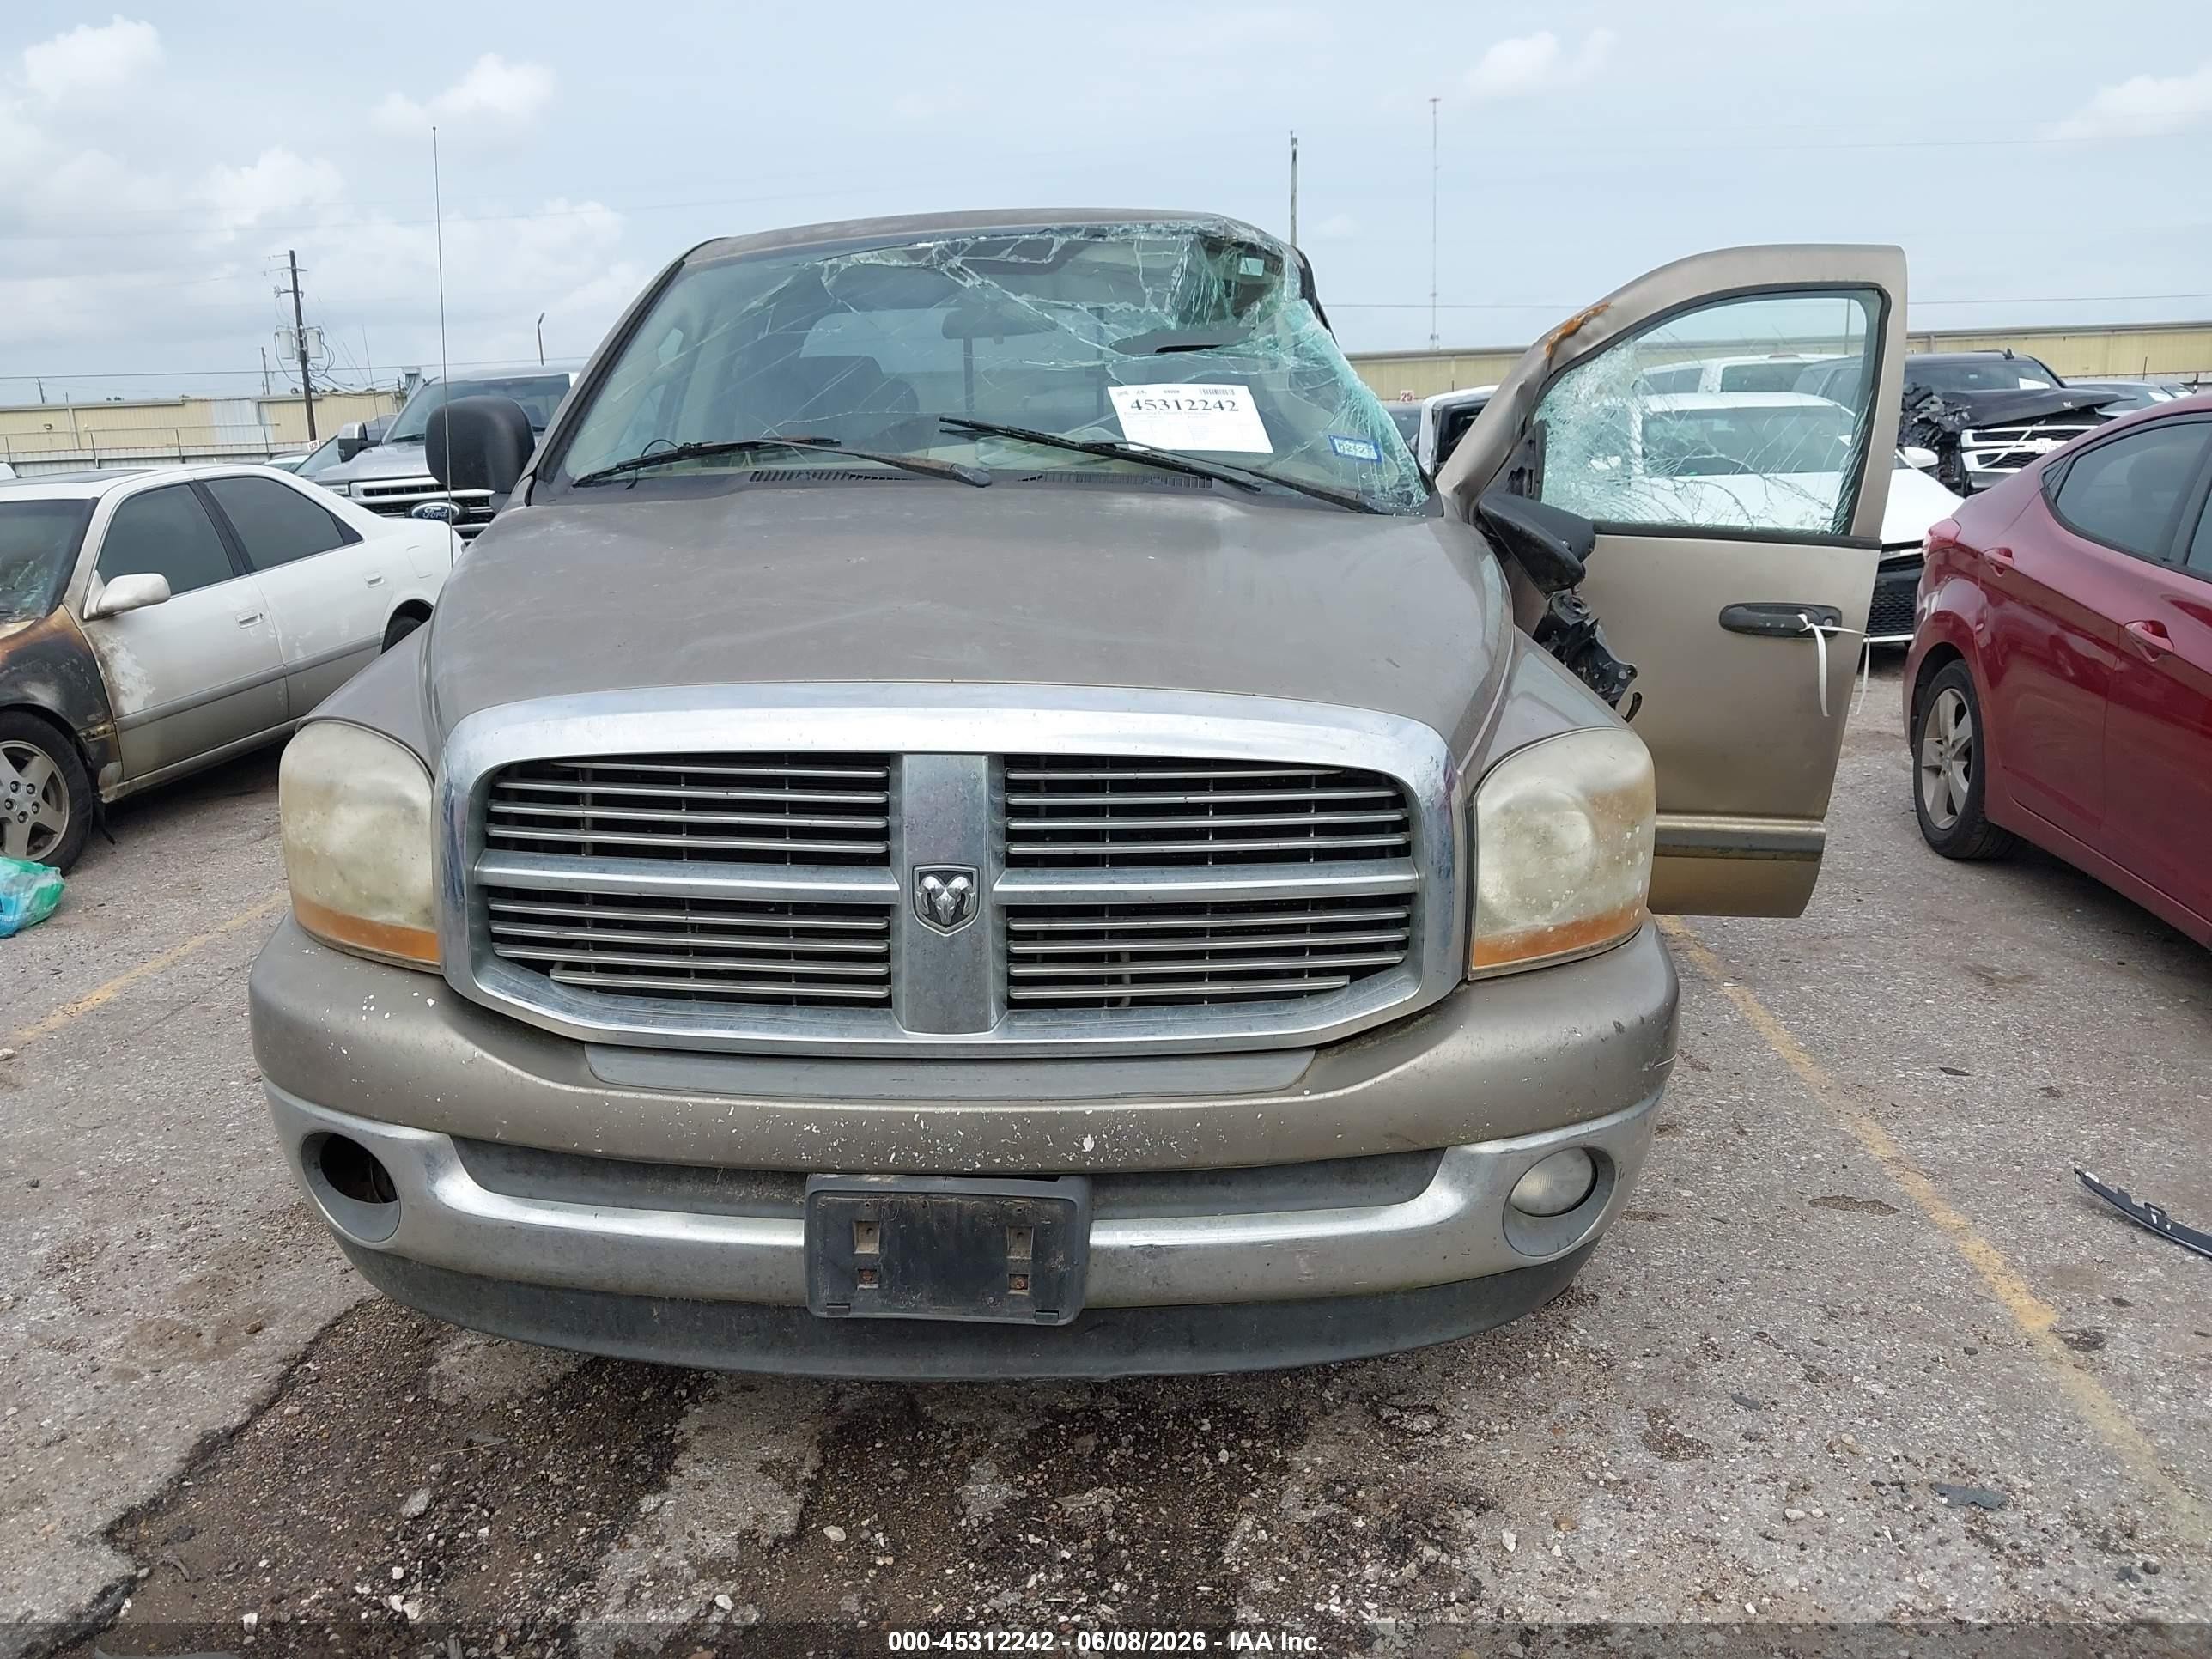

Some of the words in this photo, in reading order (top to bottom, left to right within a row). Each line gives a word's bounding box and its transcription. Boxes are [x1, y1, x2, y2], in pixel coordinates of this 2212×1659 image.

[1401, 392, 1413, 403] 25
[1130, 398, 1239, 411] 45312242
[422, 507, 448, 519] Ford
